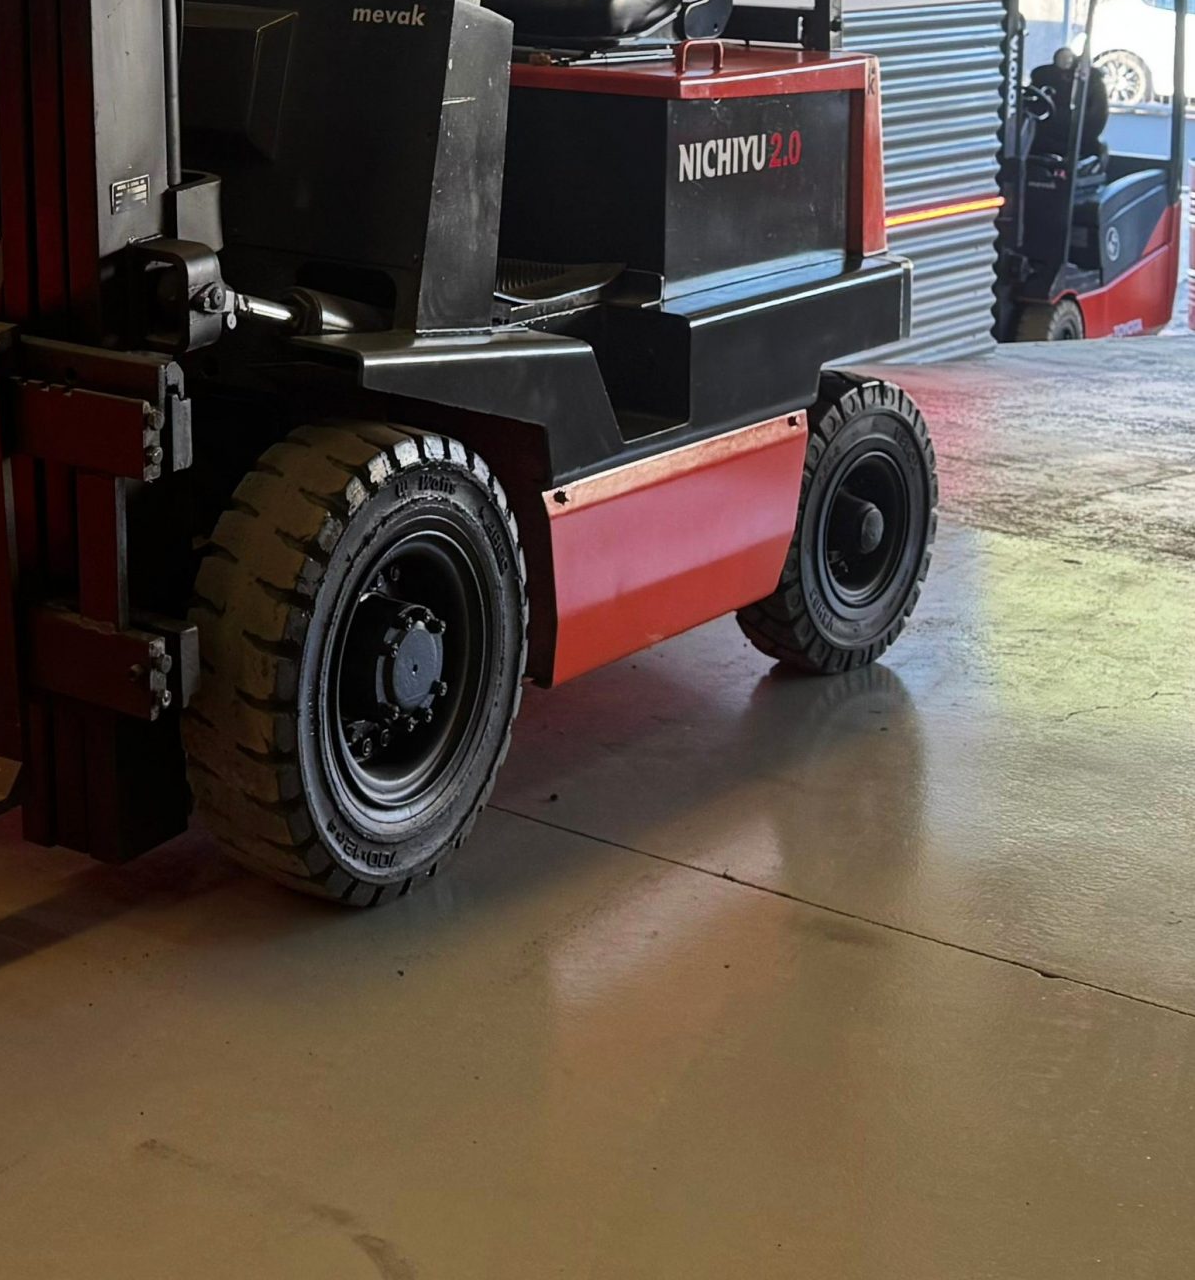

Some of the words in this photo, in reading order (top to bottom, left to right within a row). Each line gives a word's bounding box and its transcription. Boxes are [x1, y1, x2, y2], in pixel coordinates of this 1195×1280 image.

[352, 3, 426, 26] mevak
[1007, 34, 1019, 119] TOYOTA
[678, 133, 767, 182] NICHIYU
[769, 130, 802, 168] 2.0
